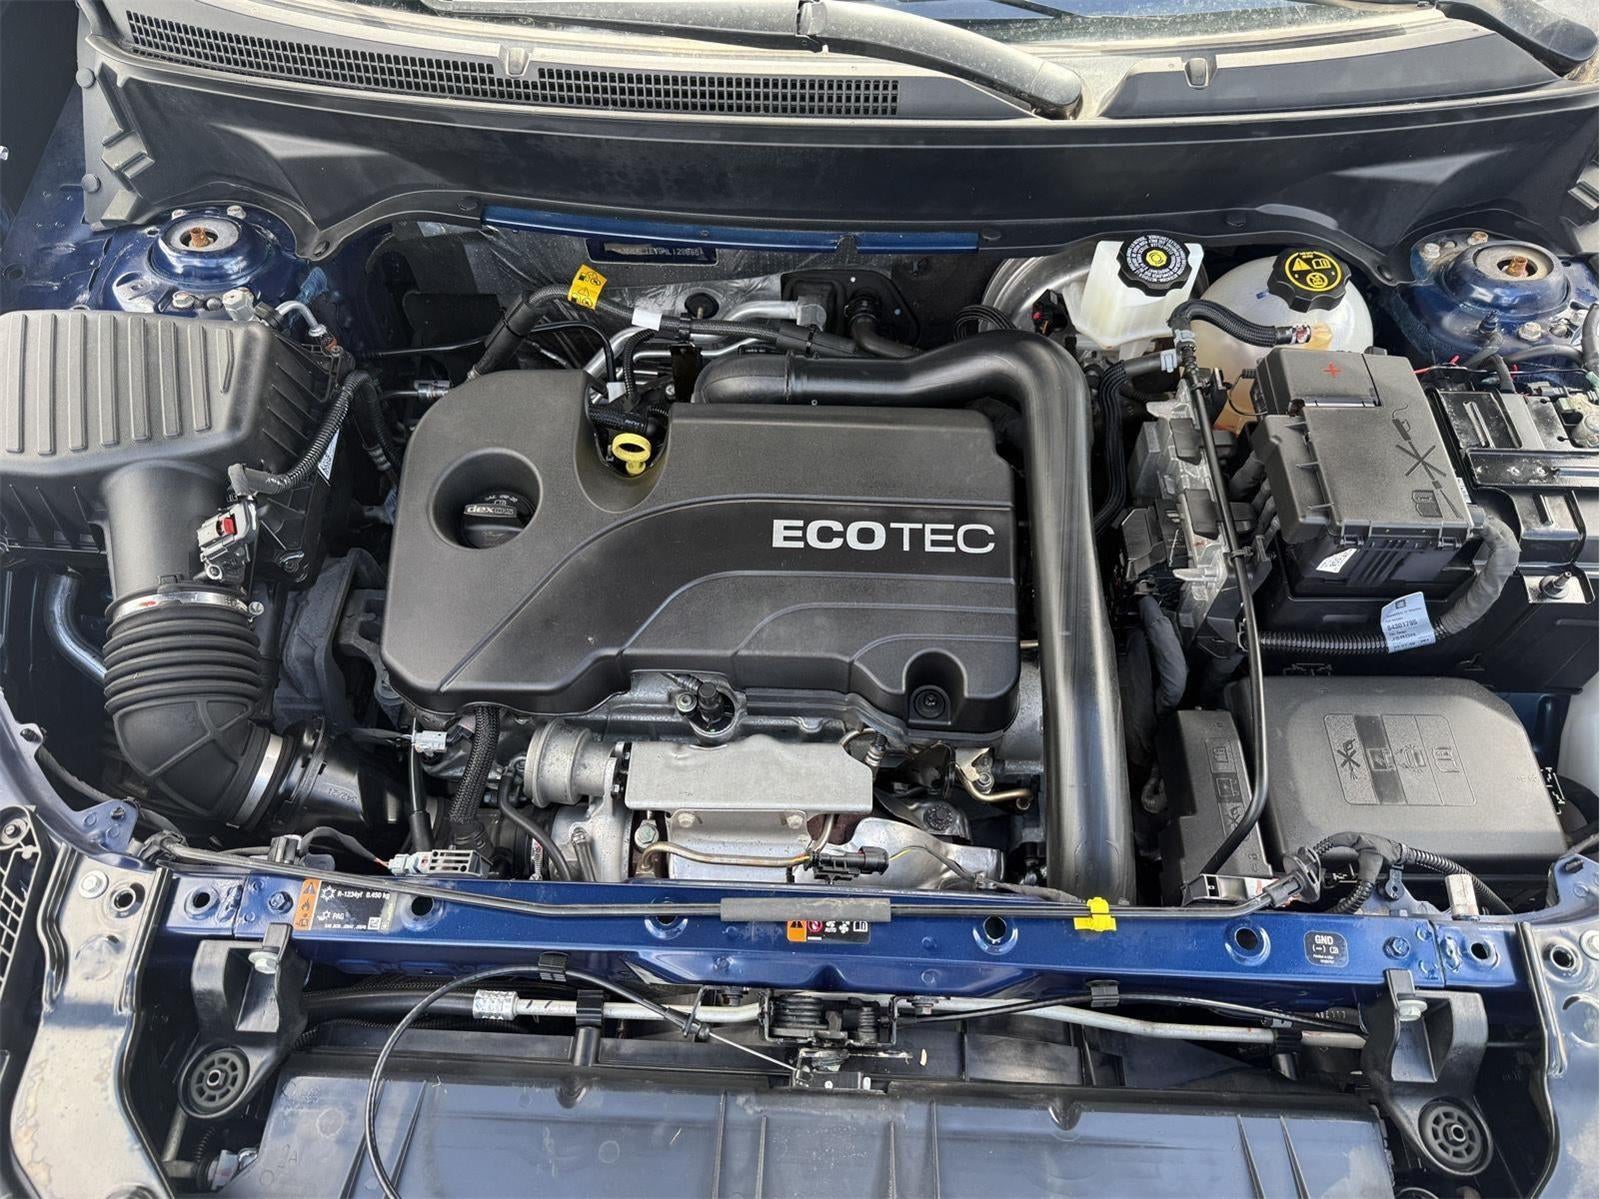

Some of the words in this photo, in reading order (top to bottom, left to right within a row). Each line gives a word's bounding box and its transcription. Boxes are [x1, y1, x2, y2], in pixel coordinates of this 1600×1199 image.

[467, 505, 514, 515] dexos
[772, 519, 995, 554] ECOTEC
[1314, 934, 1334, 945] GND
